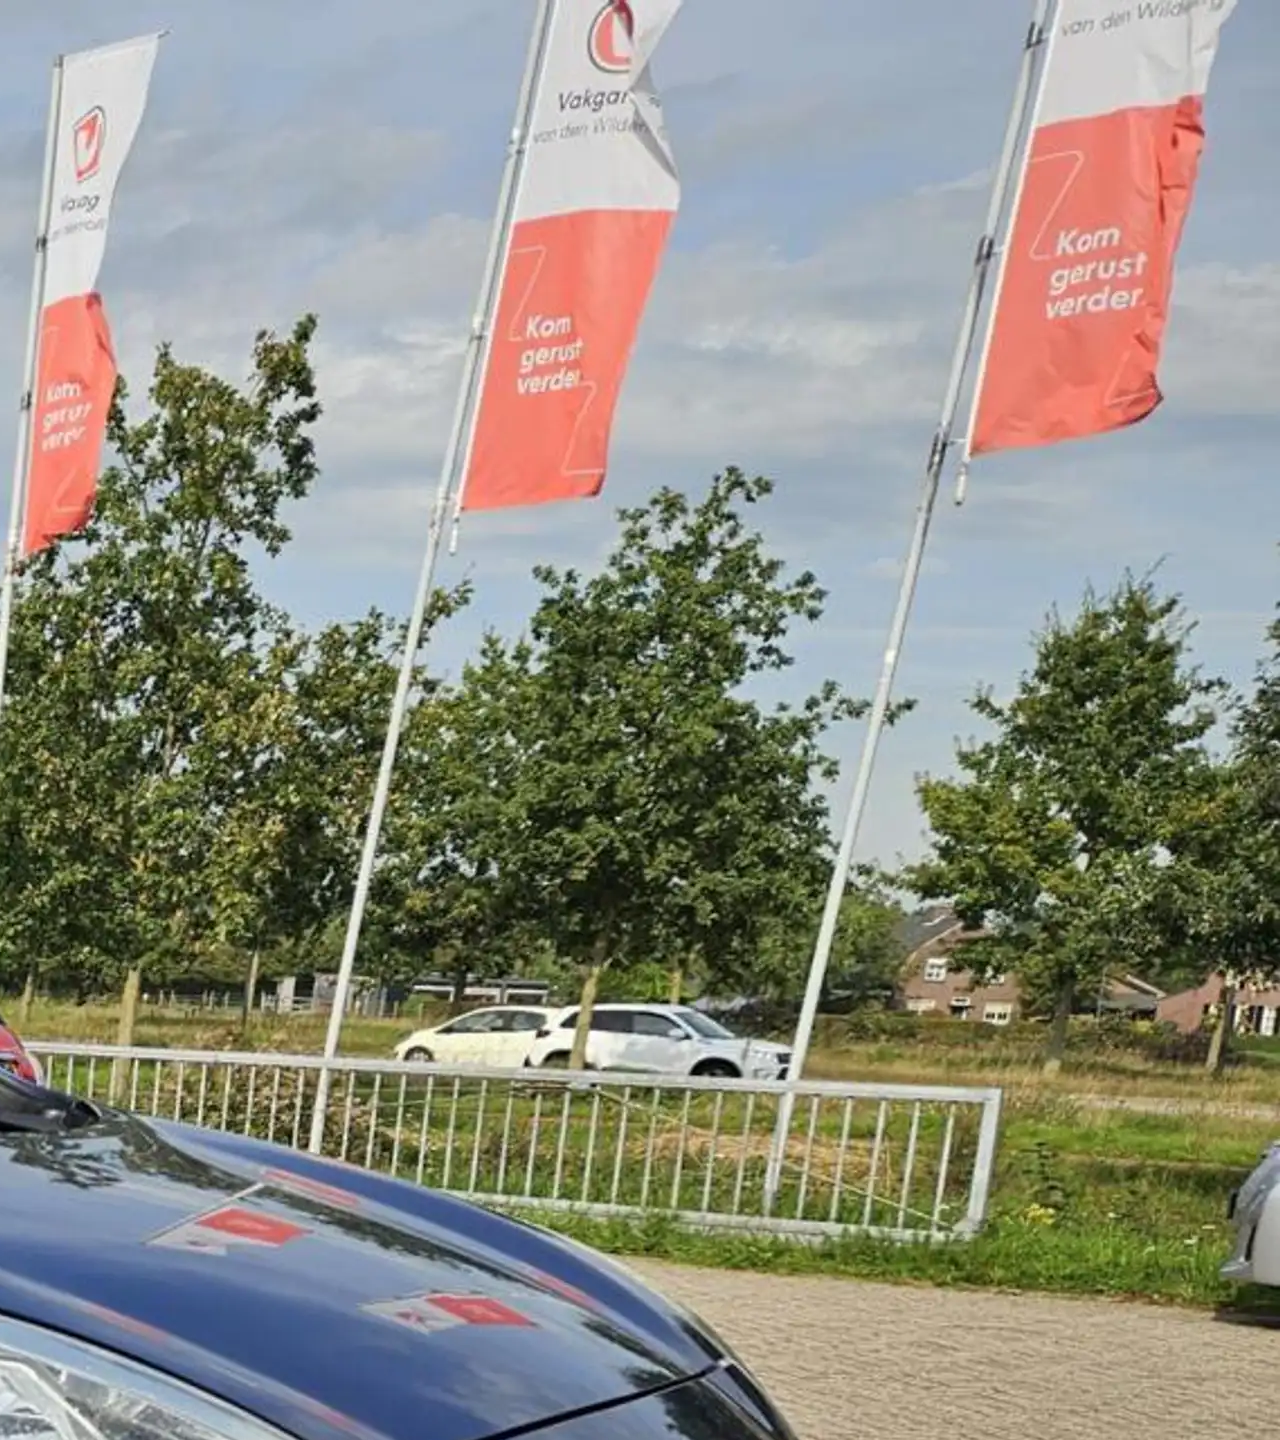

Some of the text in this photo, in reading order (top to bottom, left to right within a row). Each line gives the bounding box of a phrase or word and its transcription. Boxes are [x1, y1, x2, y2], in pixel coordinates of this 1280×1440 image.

[1062, 19, 1096, 37] van
[1056, 227, 1121, 257] Kom
[1049, 252, 1148, 296] gerust
[526, 314, 572, 341] Kom
[519, 336, 584, 374] gerust
